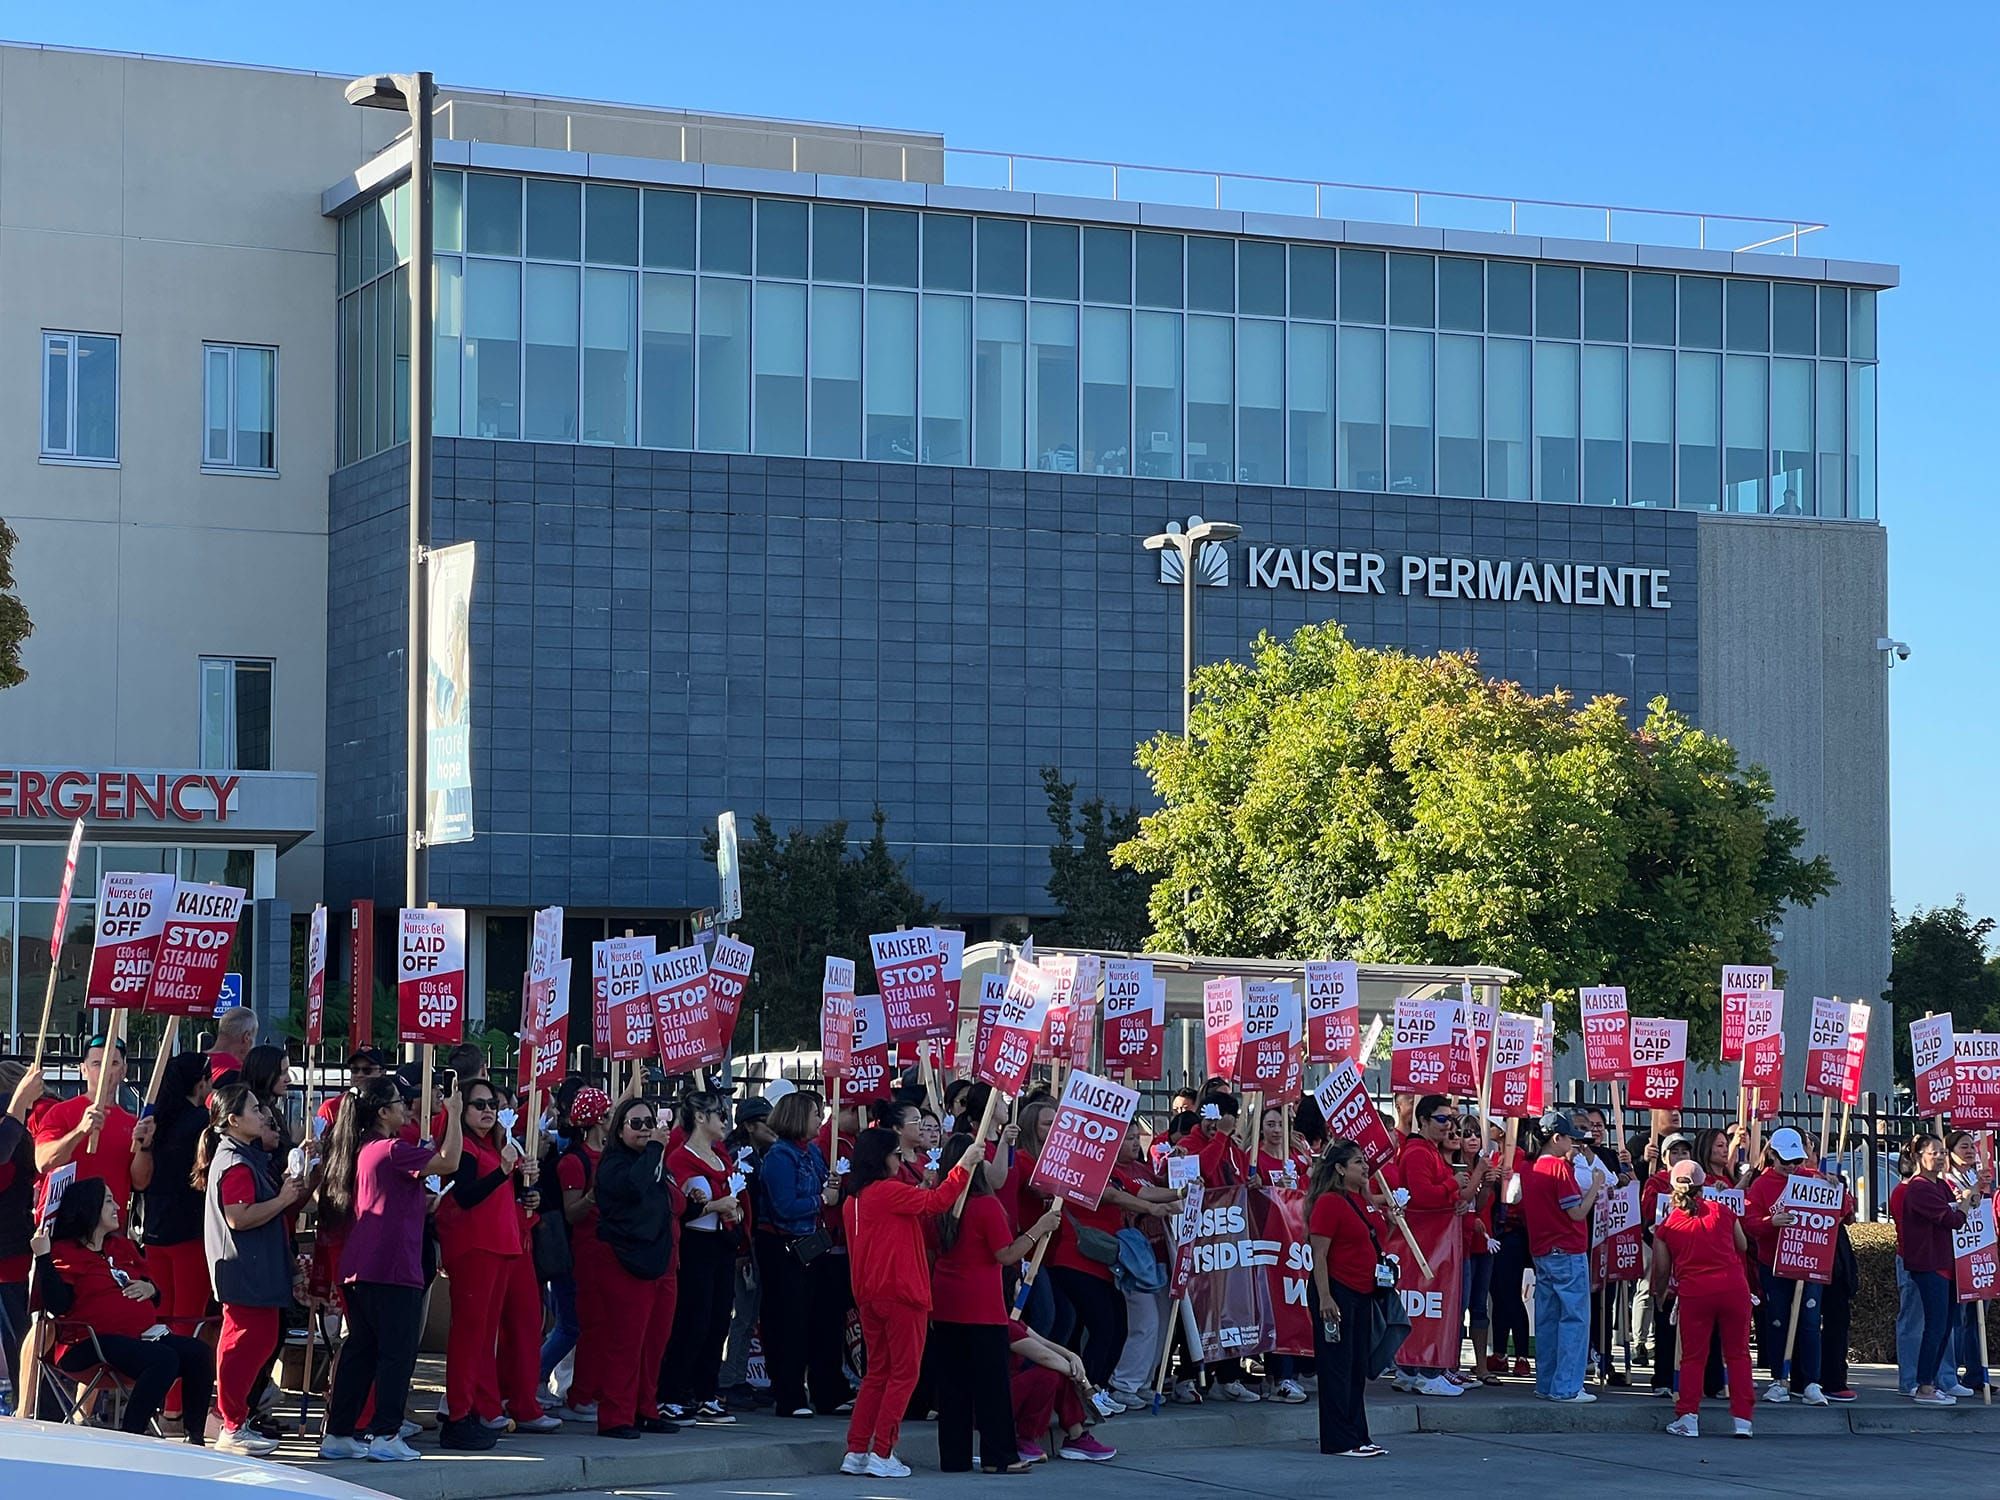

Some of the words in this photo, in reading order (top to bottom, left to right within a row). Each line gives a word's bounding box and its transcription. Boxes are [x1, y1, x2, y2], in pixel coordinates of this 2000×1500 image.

[1248, 546, 1386, 595] KAISER
[1401, 555, 1672, 609] PERMANENTE
[434, 733, 464, 754] more
[437, 760, 461, 780] hope
[108, 887, 136, 900] Nurses
[138, 888, 152, 900] Get
[105, 901, 151, 918] LAID
[176, 892, 239, 918] KAISER!
[102, 920, 141, 937] OFF
[404, 922, 429, 934] Nurses
[431, 923, 445, 935] Get
[167, 926, 229, 950] STOP
[404, 937, 445, 953] LAID
[117, 947, 135, 958] CEOs
[137, 947, 150, 959] Get
[877, 936, 932, 960] KAISER!
[161, 949, 218, 969] STEALING
[611, 951, 631, 962] Nurses
[632, 950, 642, 960] Get
[715, 944, 750, 972] KAISER!
[114, 960, 154, 975] PAID
[402, 956, 438, 972] OFF
[612, 962, 643, 979] LAID
[652, 954, 703, 984] KAISER!
[158, 965, 186, 982] OUR
[881, 965, 936, 987] STOP
[1109, 971, 1129, 980] Nurses
[1130, 971, 1140, 980] Get
[1309, 972, 1331, 981] Nurses
[1333, 972, 1343, 981] Get
[110, 977, 147, 993] OFF
[154, 982, 202, 1000] WAGES!
[420, 982, 437, 994] CEOs
[438, 982, 451, 994] Get
[611, 980, 639, 996] OFF
[709, 973, 743, 998] STOP
[1109, 982, 1140, 996] LAID
[1310, 983, 1344, 995] LAID
[658, 985, 707, 1013] STOP
[885, 984, 936, 1003] STEALING
[1008, 985, 1035, 1009] LAID
[1208, 990, 1224, 999] Nurses
[1249, 994, 1268, 1003] Nurses
[1270, 993, 1279, 1003] Get
[419, 995, 457, 1011] PAID
[626, 1003, 640, 1014] CEOs
[826, 997, 850, 1016] STOP
[1108, 997, 1135, 1011] OFF
[1208, 1000, 1232, 1014] LAID
[1310, 997, 1340, 1010] OFF
[1585, 994, 1623, 1010] KAISER!
[888, 1003, 911, 1016] OUR
[1002, 1002, 1026, 1024] OFF
[1248, 1005, 1279, 1019] LAID
[1399, 1008, 1422, 1018] Nurses
[1424, 1010, 1436, 1018] Get
[1749, 1010, 1772, 1022] LAID
[1815, 1007, 1834, 1019] Nurses
[418, 1012, 451, 1028] OFF
[626, 1014, 654, 1030] PAID
[661, 1006, 709, 1031] STEALING
[890, 1012, 932, 1030] WAGES!
[1120, 1018, 1133, 1028] CEOs
[1134, 1018, 1144, 1028] Get
[1208, 1014, 1230, 1028] OFF
[1325, 1016, 1339, 1025] CEOs
[1340, 1016, 1351, 1025] Get
[1398, 1019, 1436, 1031] LAID
[1586, 1018, 1625, 1032] STOP
[1814, 1017, 1845, 1034] LAID
[1247, 1021, 1273, 1033] OFF
[1325, 1025, 1355, 1038] PAID
[1499, 1028, 1516, 1037] Nurses
[1635, 1028, 1657, 1037] Nurses
[1660, 1029, 1671, 1037] Get
[1748, 1024, 1768, 1036] OFF
[626, 1030, 652, 1045] OFF
[663, 1029, 687, 1045] OUR
[1004, 1030, 1017, 1045] CEOs
[1017, 1034, 1029, 1048] Get
[1120, 1028, 1148, 1041] PAID
[1397, 1032, 1429, 1044] OFF
[1587, 1035, 1623, 1046] STEALING
[1813, 1031, 1839, 1046] OFF
[666, 1038, 706, 1060] WAGES!
[1119, 1042, 1144, 1055] OFF
[1258, 1041, 1271, 1050] CEOs
[1272, 1041, 1281, 1051] Get
[1325, 1039, 1351, 1051] OFF
[1498, 1038, 1524, 1051] LAID
[1634, 1038, 1670, 1049] LAID
[1915, 1037, 1942, 1053] LAID
[999, 1042, 1028, 1066] PAID
[1258, 1052, 1285, 1065] PAID
[1411, 1050, 1426, 1060] CEOs
[1428, 1051, 1440, 1060] Get
[1496, 1052, 1520, 1064] OFF
[1589, 1047, 1606, 1058] OUR
[1633, 1050, 1664, 1061] OFF
[1755, 1052, 1776, 1063] PAID
[1917, 1051, 1939, 1067] OFF
[865, 1055, 877, 1065] Get
[1410, 1060, 1445, 1072] PAID
[1589, 1058, 1620, 1070] WAGES!
[994, 1058, 1021, 1080] OFF
[1256, 1065, 1280, 1079] OFF
[1646, 1067, 1662, 1076] CEOs
[1664, 1068, 1674, 1076] Get
[1754, 1064, 1773, 1076] OFF
[1955, 1065, 2000, 1081] STOP
[1409, 1072, 1439, 1084] OFF
[1646, 1076, 1679, 1088] PAID
[1820, 1073, 1843, 1088] OFF
[1929, 1076, 1953, 1092] PAID
[846, 1079, 879, 1094] OFF
[1320, 1067, 1357, 1111] KAISER!
[1505, 1081, 1527, 1093] PAID
[1645, 1088, 1674, 1099] OFF
[1070, 1080, 1130, 1118] KAISER!
[1503, 1094, 1523, 1106] OFF
[1930, 1088, 1951, 1104] OFF
[1332, 1092, 1366, 1135] STOP
[1955, 1107, 1993, 1118] WAGES!
[1057, 1111, 1118, 1144] STOP
[1343, 1112, 1373, 1142] TEALING
[1051, 1130, 1106, 1162] STEALING
[1046, 1147, 1071, 1168] OUR
[1041, 1160, 1085, 1188] WAGES!
[1792, 1182, 1840, 1206] KAISER!
[1608, 1216, 1626, 1229] OFF
[1788, 1210, 1835, 1230] STOP
[1784, 1227, 1828, 1245] STEALING
[1957, 1237, 1981, 1249] OFF
[1617, 1245, 1639, 1257] PAID
[1783, 1240, 1803, 1253] OUR
[1617, 1257, 1637, 1269] OFF
[1781, 1252, 1818, 1270] WAGES!
[1972, 1263, 1996, 1276] PAID
[1972, 1275, 1994, 1289] OFF
